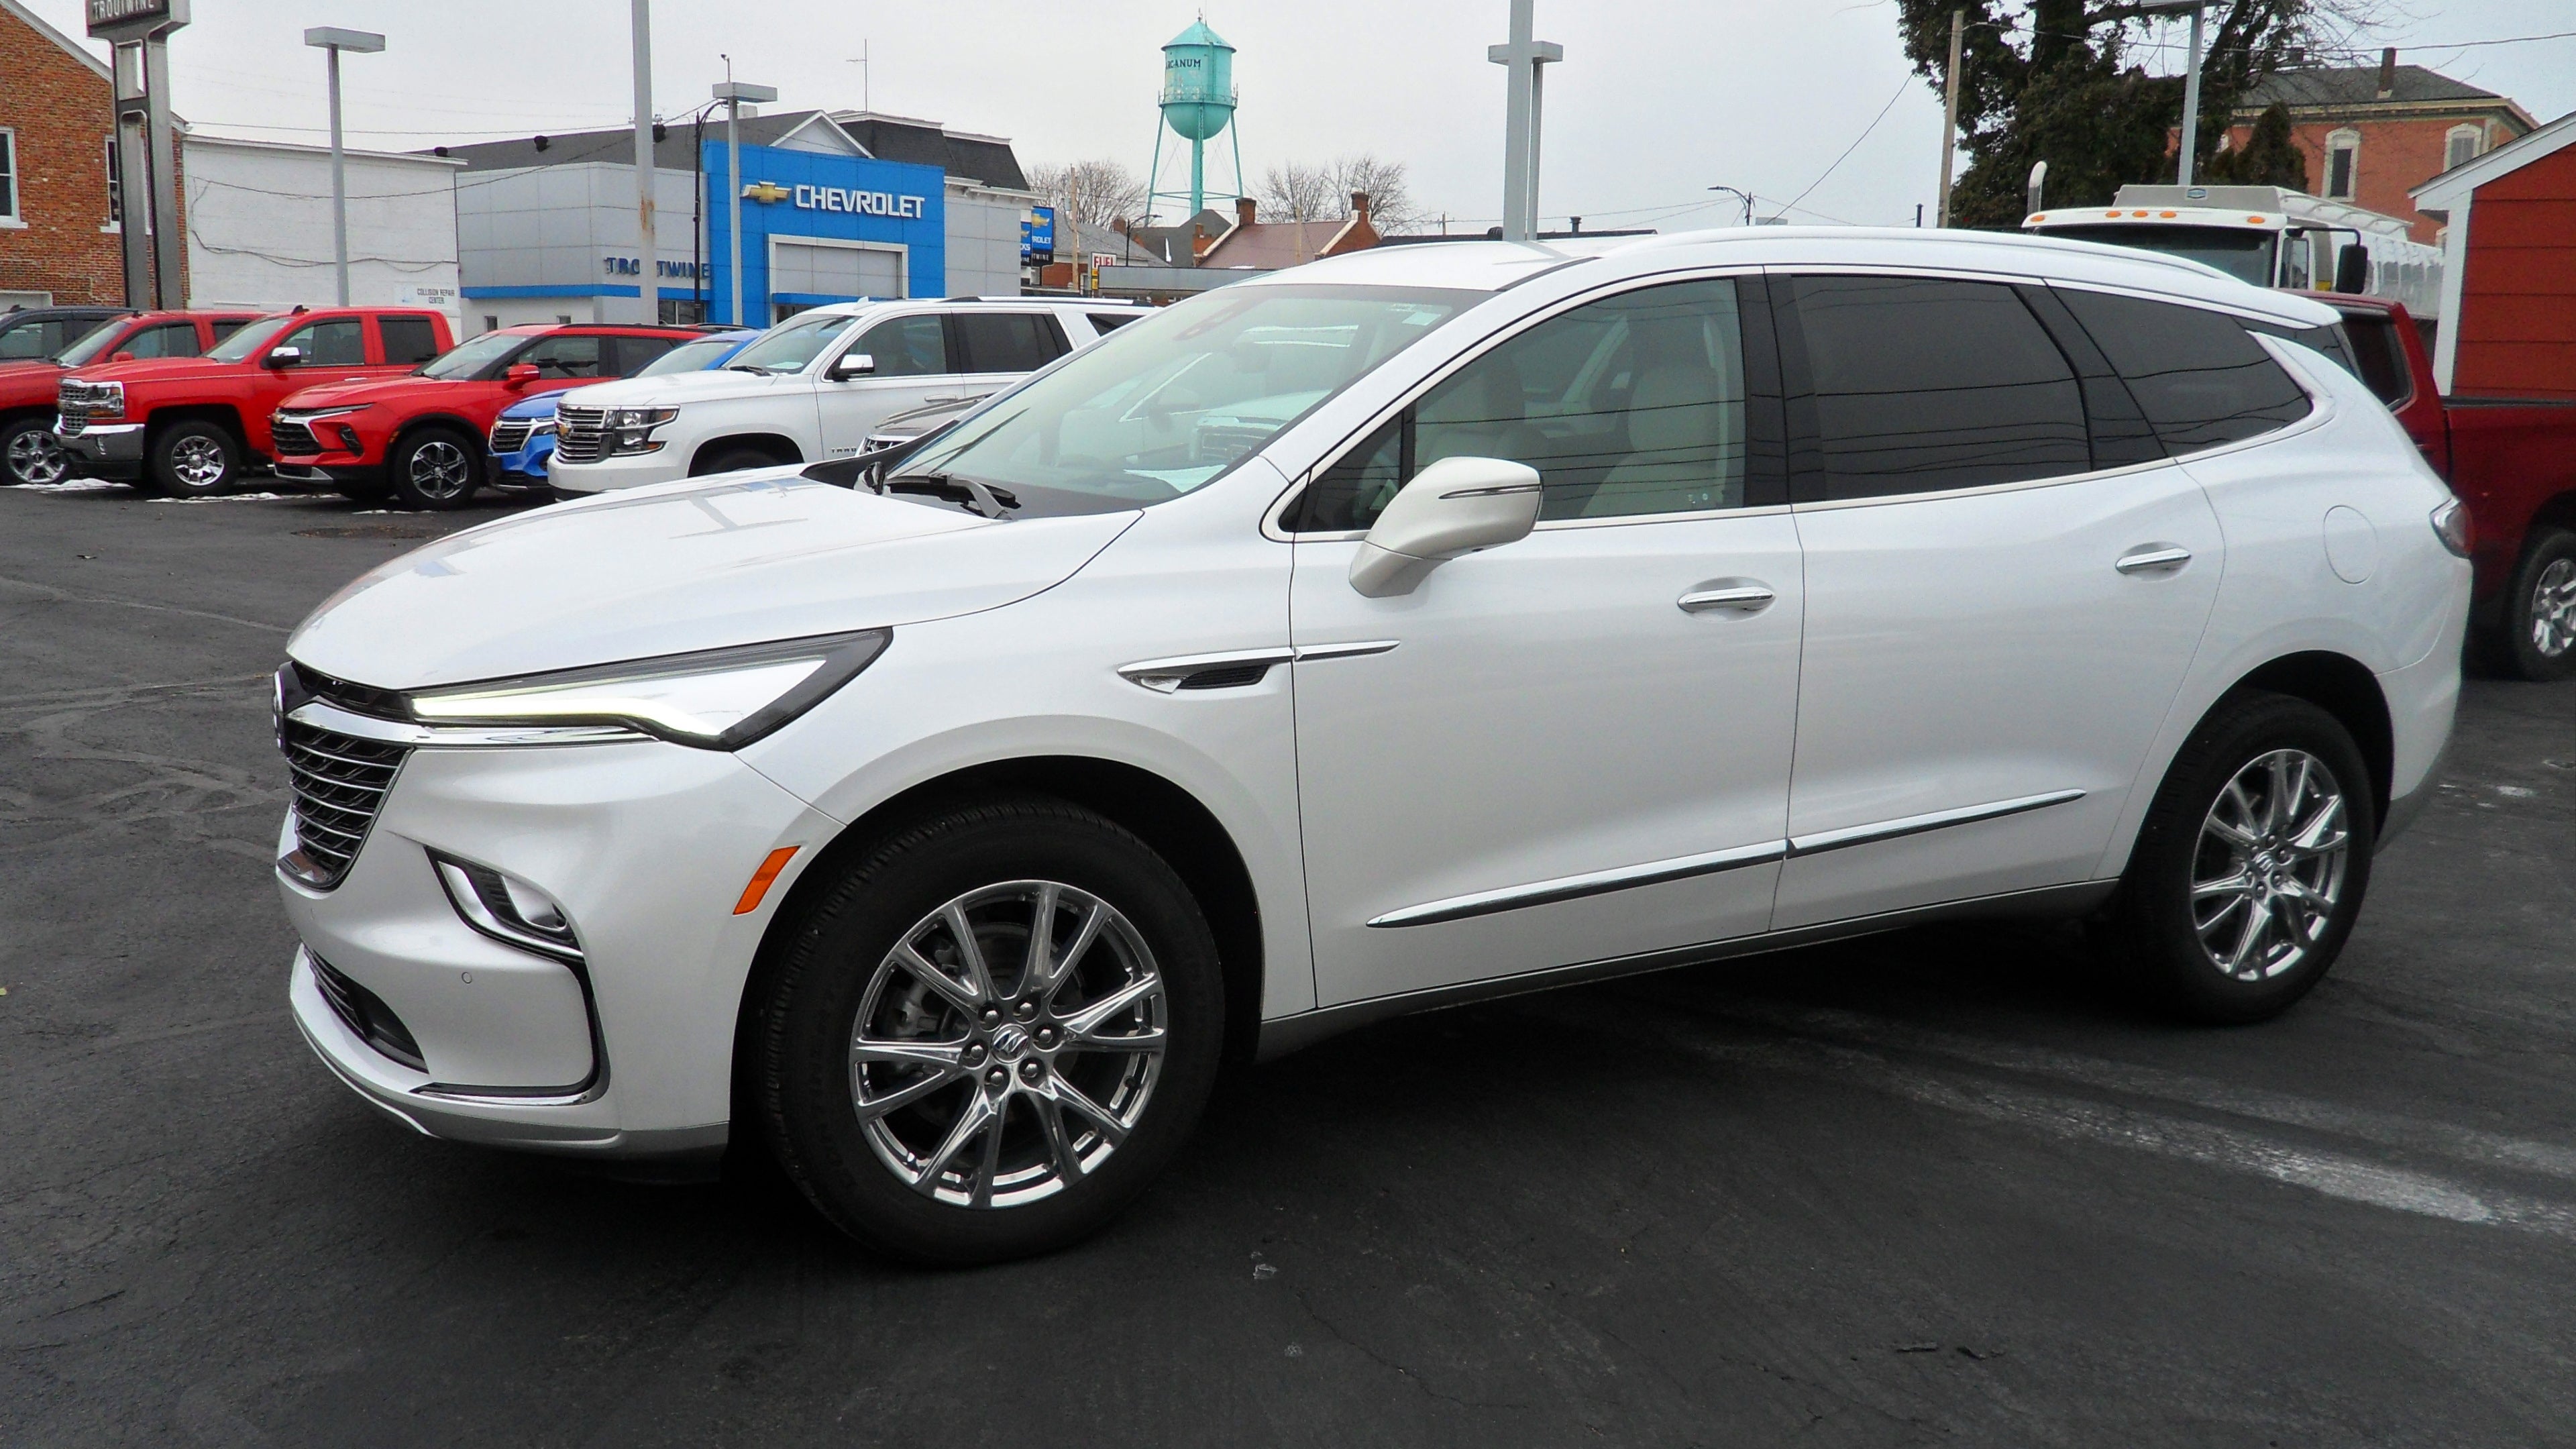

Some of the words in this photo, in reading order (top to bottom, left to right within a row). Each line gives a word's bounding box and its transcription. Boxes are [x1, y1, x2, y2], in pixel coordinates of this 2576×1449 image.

[796, 184, 925, 219] CHEVROLET
[1032, 235, 1051, 244] ROLET
[605, 257, 710, 278] TROTWINE
[417, 288, 439, 296] COLLISION
